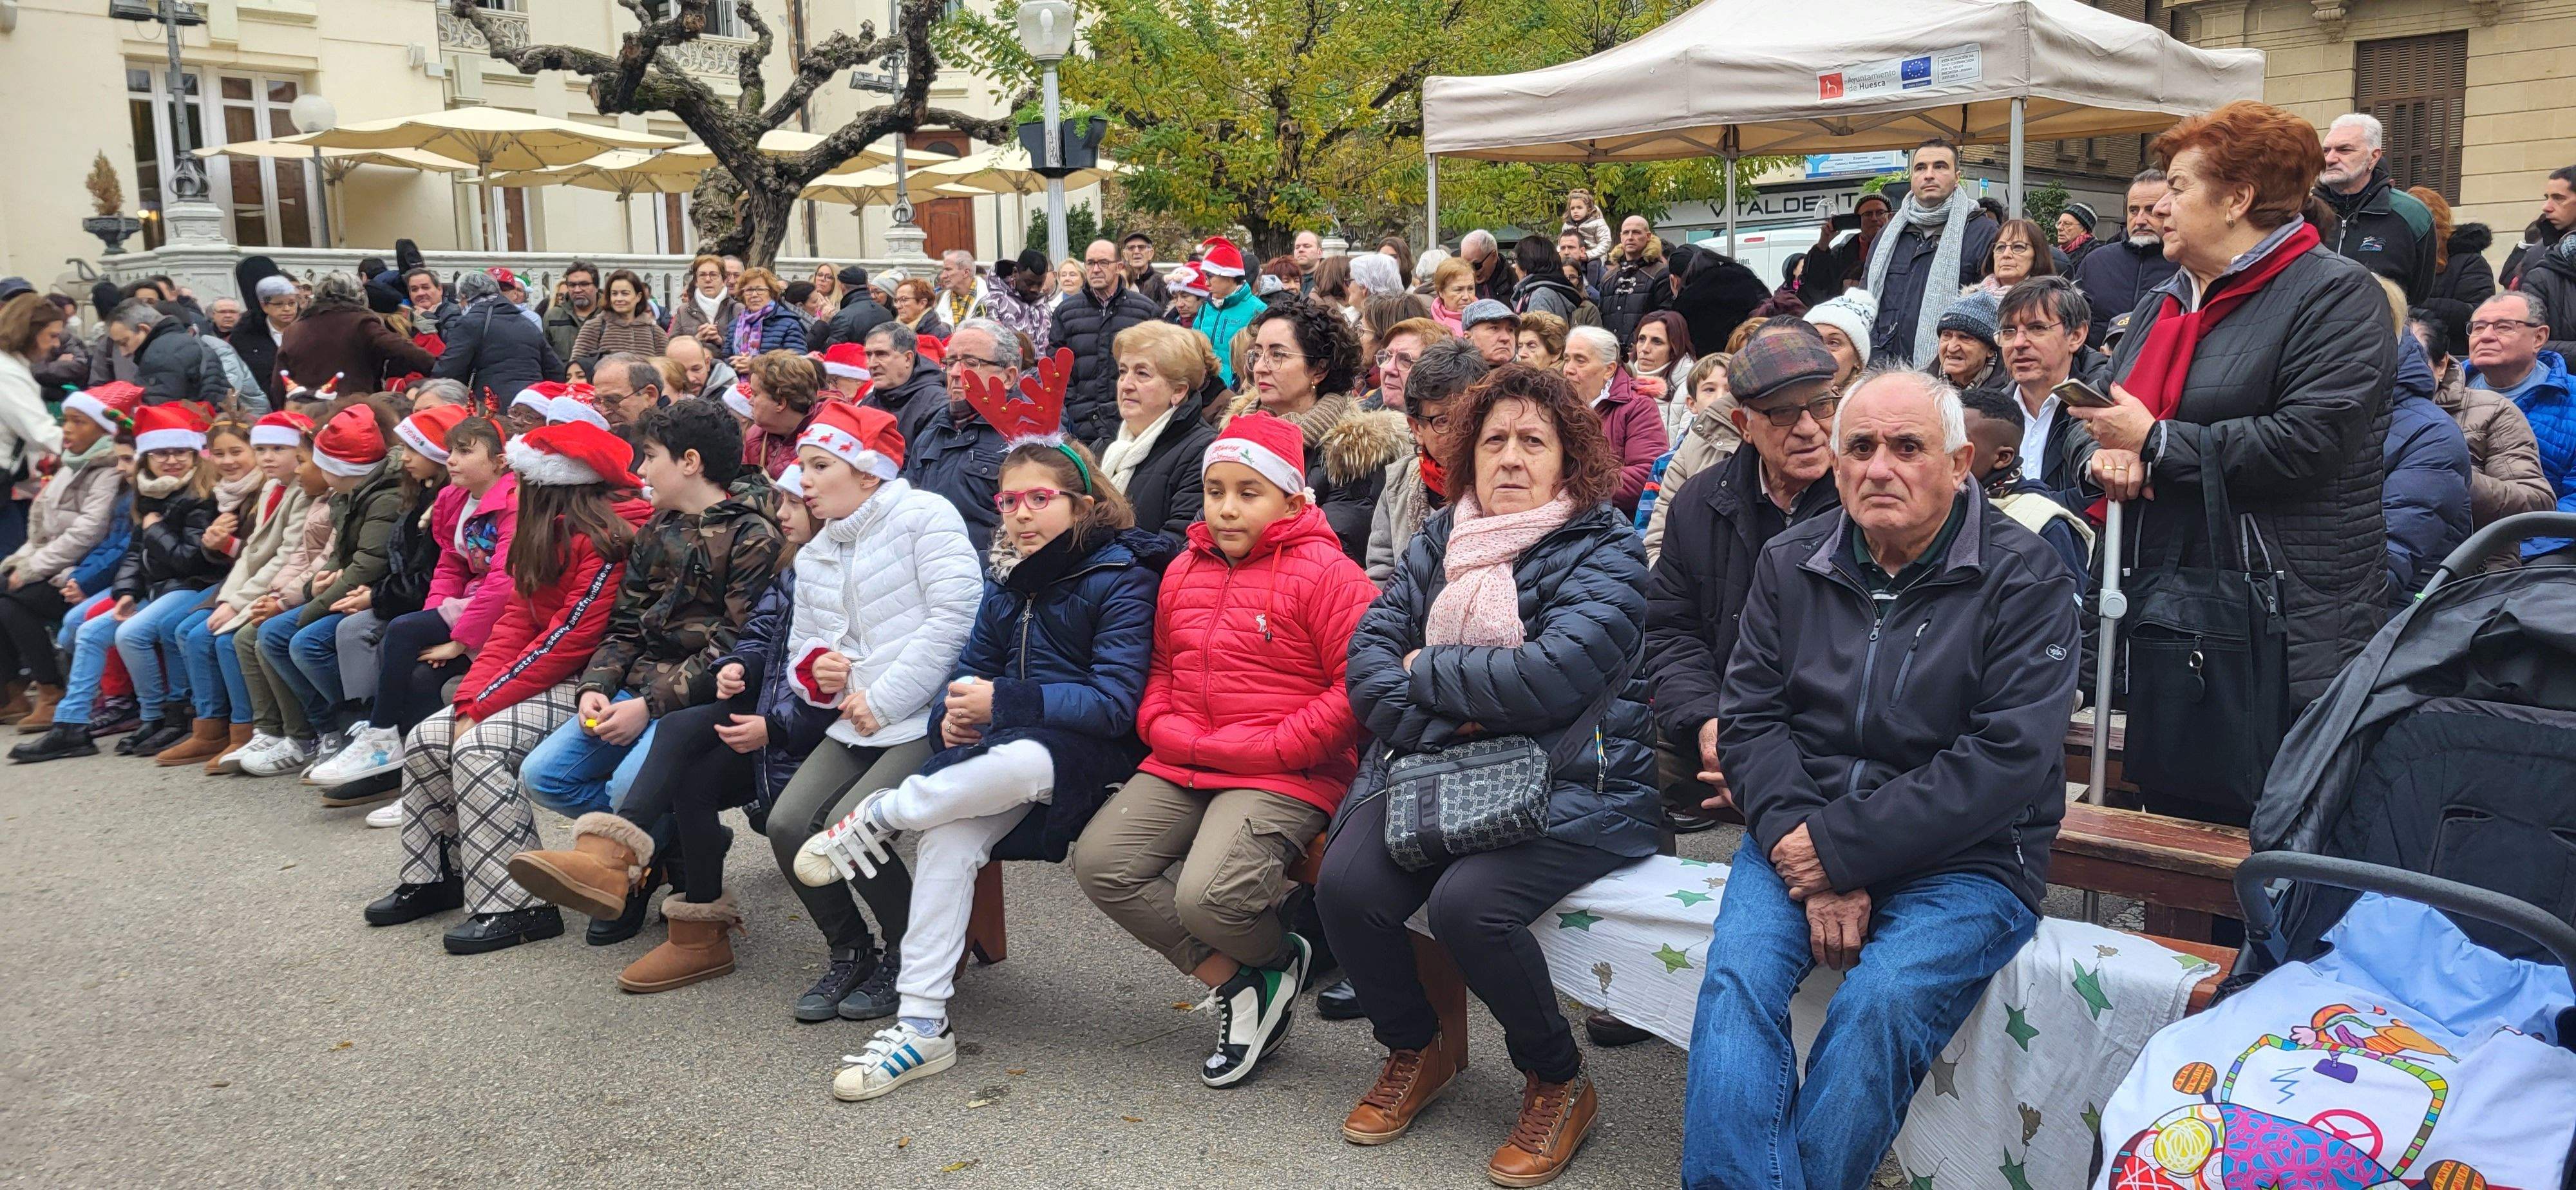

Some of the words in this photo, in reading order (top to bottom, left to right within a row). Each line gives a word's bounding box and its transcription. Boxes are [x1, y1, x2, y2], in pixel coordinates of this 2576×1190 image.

[1848, 70, 1896, 84] Ayuntamiento
[1859, 80, 1886, 90] Huesca
[1710, 193, 1859, 218] VTALDET
